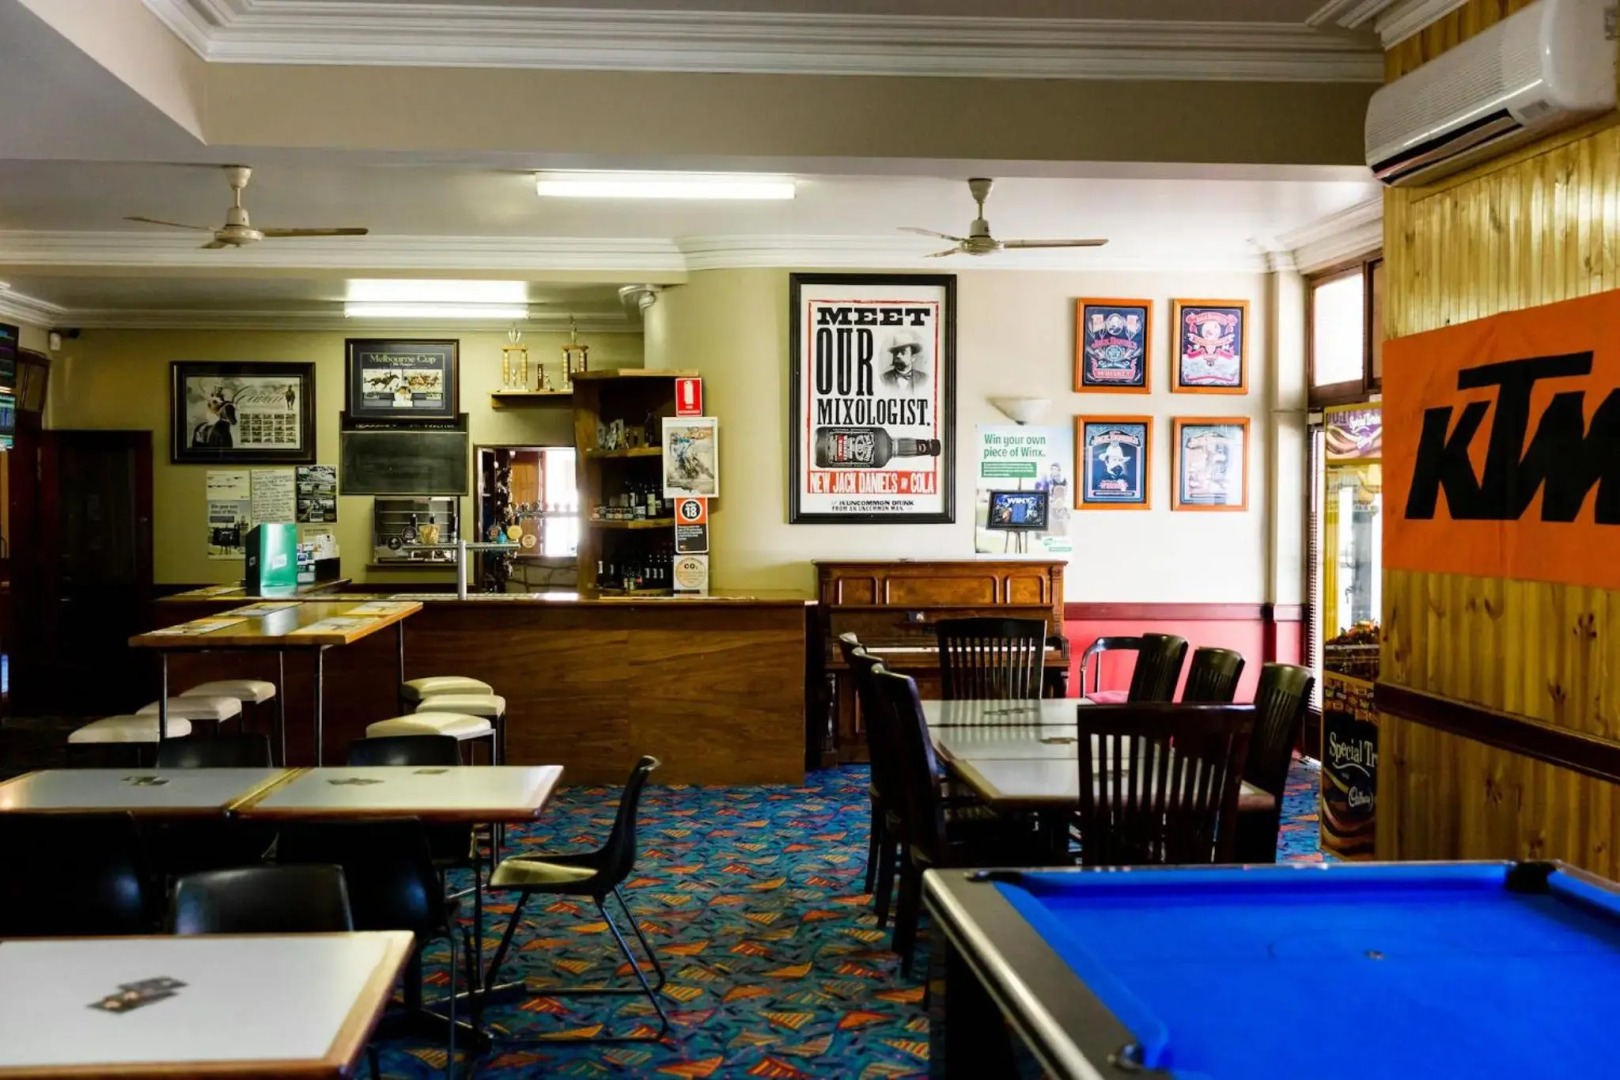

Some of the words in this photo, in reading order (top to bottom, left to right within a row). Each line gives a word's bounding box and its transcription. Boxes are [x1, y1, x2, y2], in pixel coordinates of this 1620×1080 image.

[817, 307, 931, 326] MEET
[370, 354, 416, 363] Melbourne
[417, 354, 436, 364] Cup
[816, 328, 874, 396] OUR
[817, 398, 931, 427] MIXOLOGIST.
[984, 433, 1001, 445] Win
[1003, 436, 1024, 447] your
[1026, 436, 1046, 445] own
[1404, 350, 1620, 525] KTM
[983, 447, 1008, 459] piece
[1009, 446, 1019, 457] of
[1021, 447, 1046, 457] Winx.
[810, 472, 831, 494] NEW
[832, 472, 857, 494] JACK
[910, 472, 934, 494] COLA
[685, 506, 697, 517] 18
[1328, 731, 1363, 763] Special
